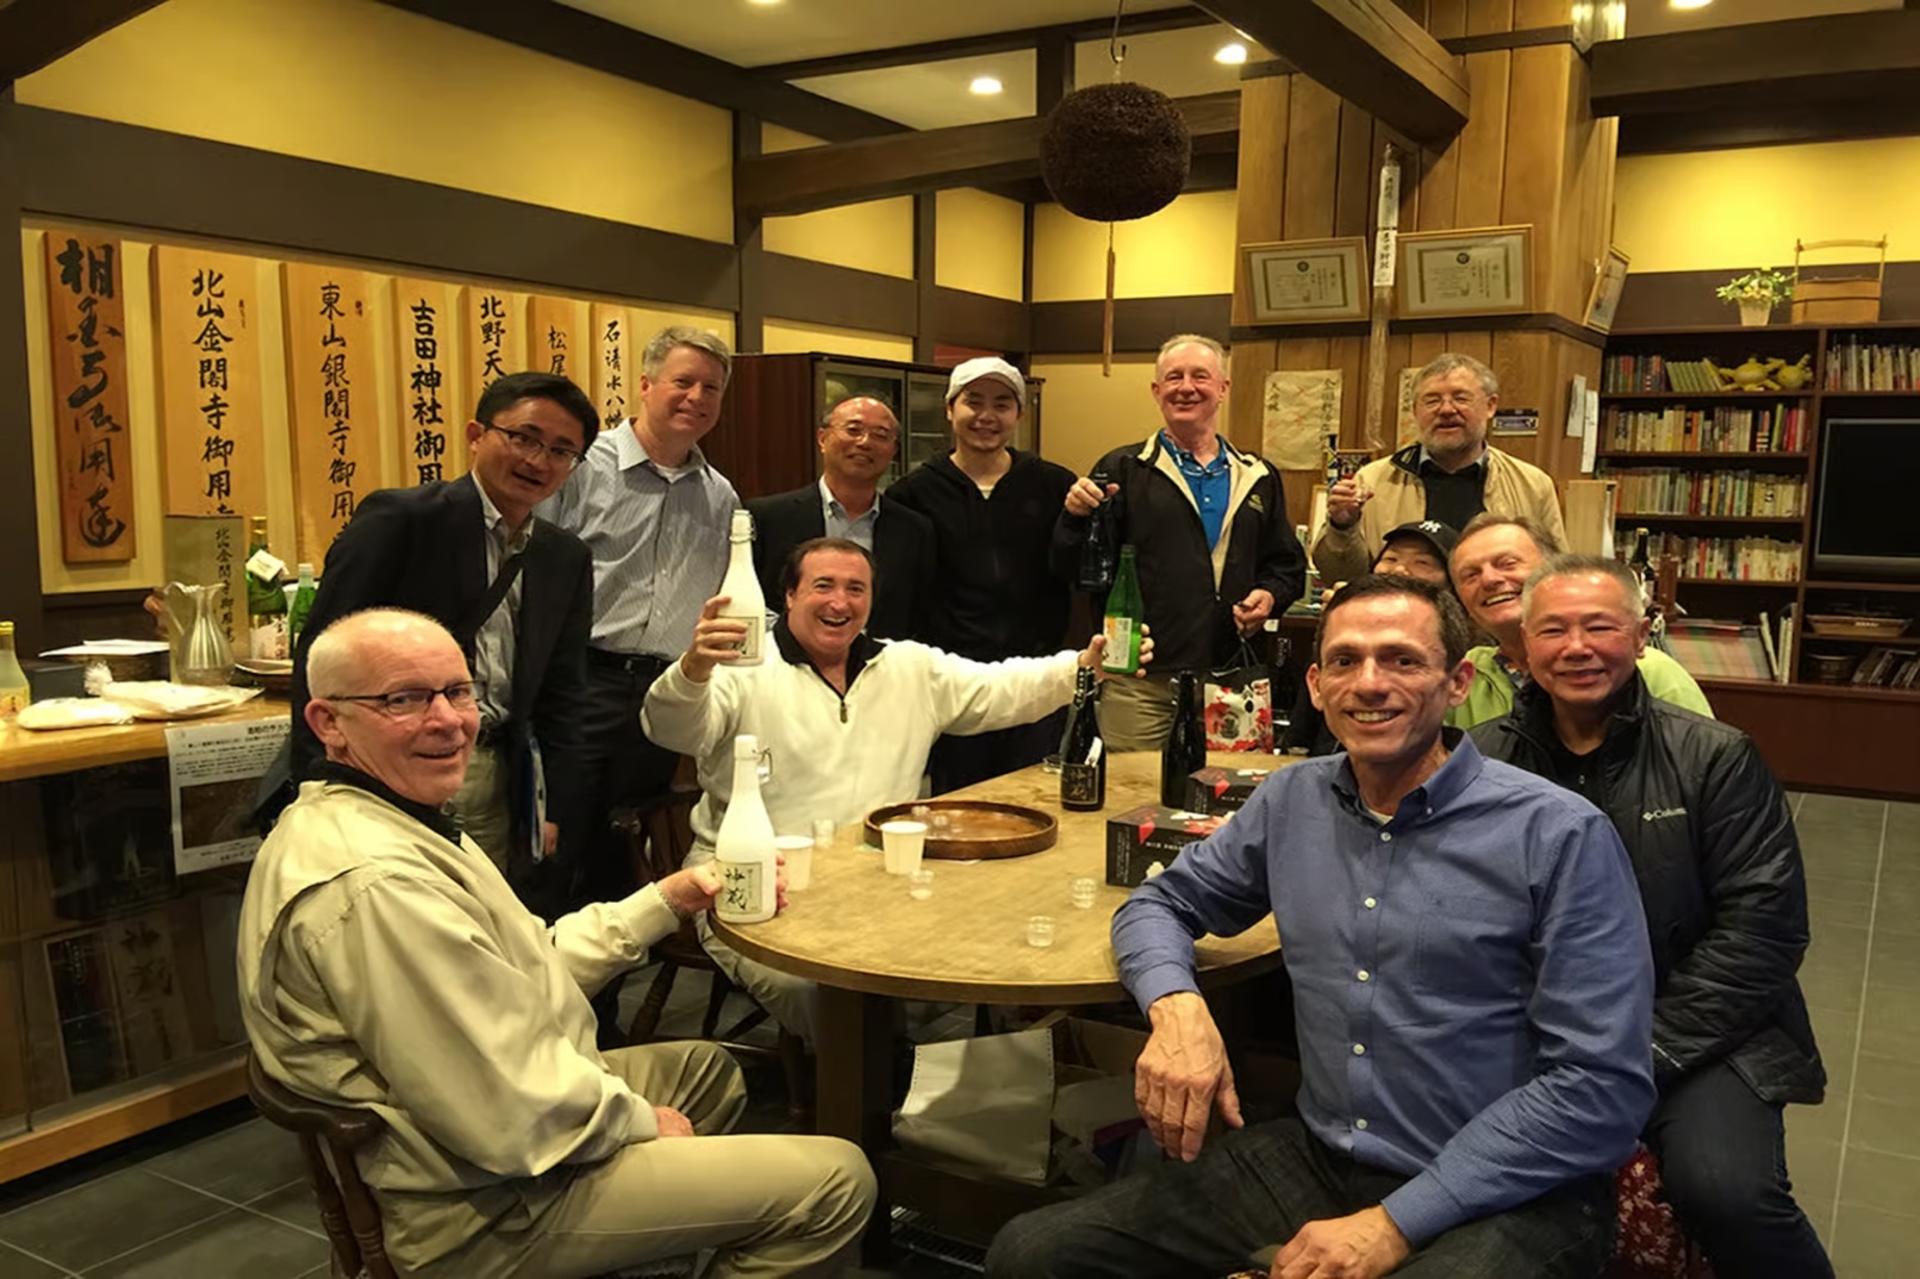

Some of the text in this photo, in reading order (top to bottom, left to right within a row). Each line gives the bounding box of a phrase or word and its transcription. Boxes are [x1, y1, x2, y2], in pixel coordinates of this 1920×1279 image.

[319, 282, 356, 542] 東山銀閣寺御用
[480, 296, 506, 391] 北野天
